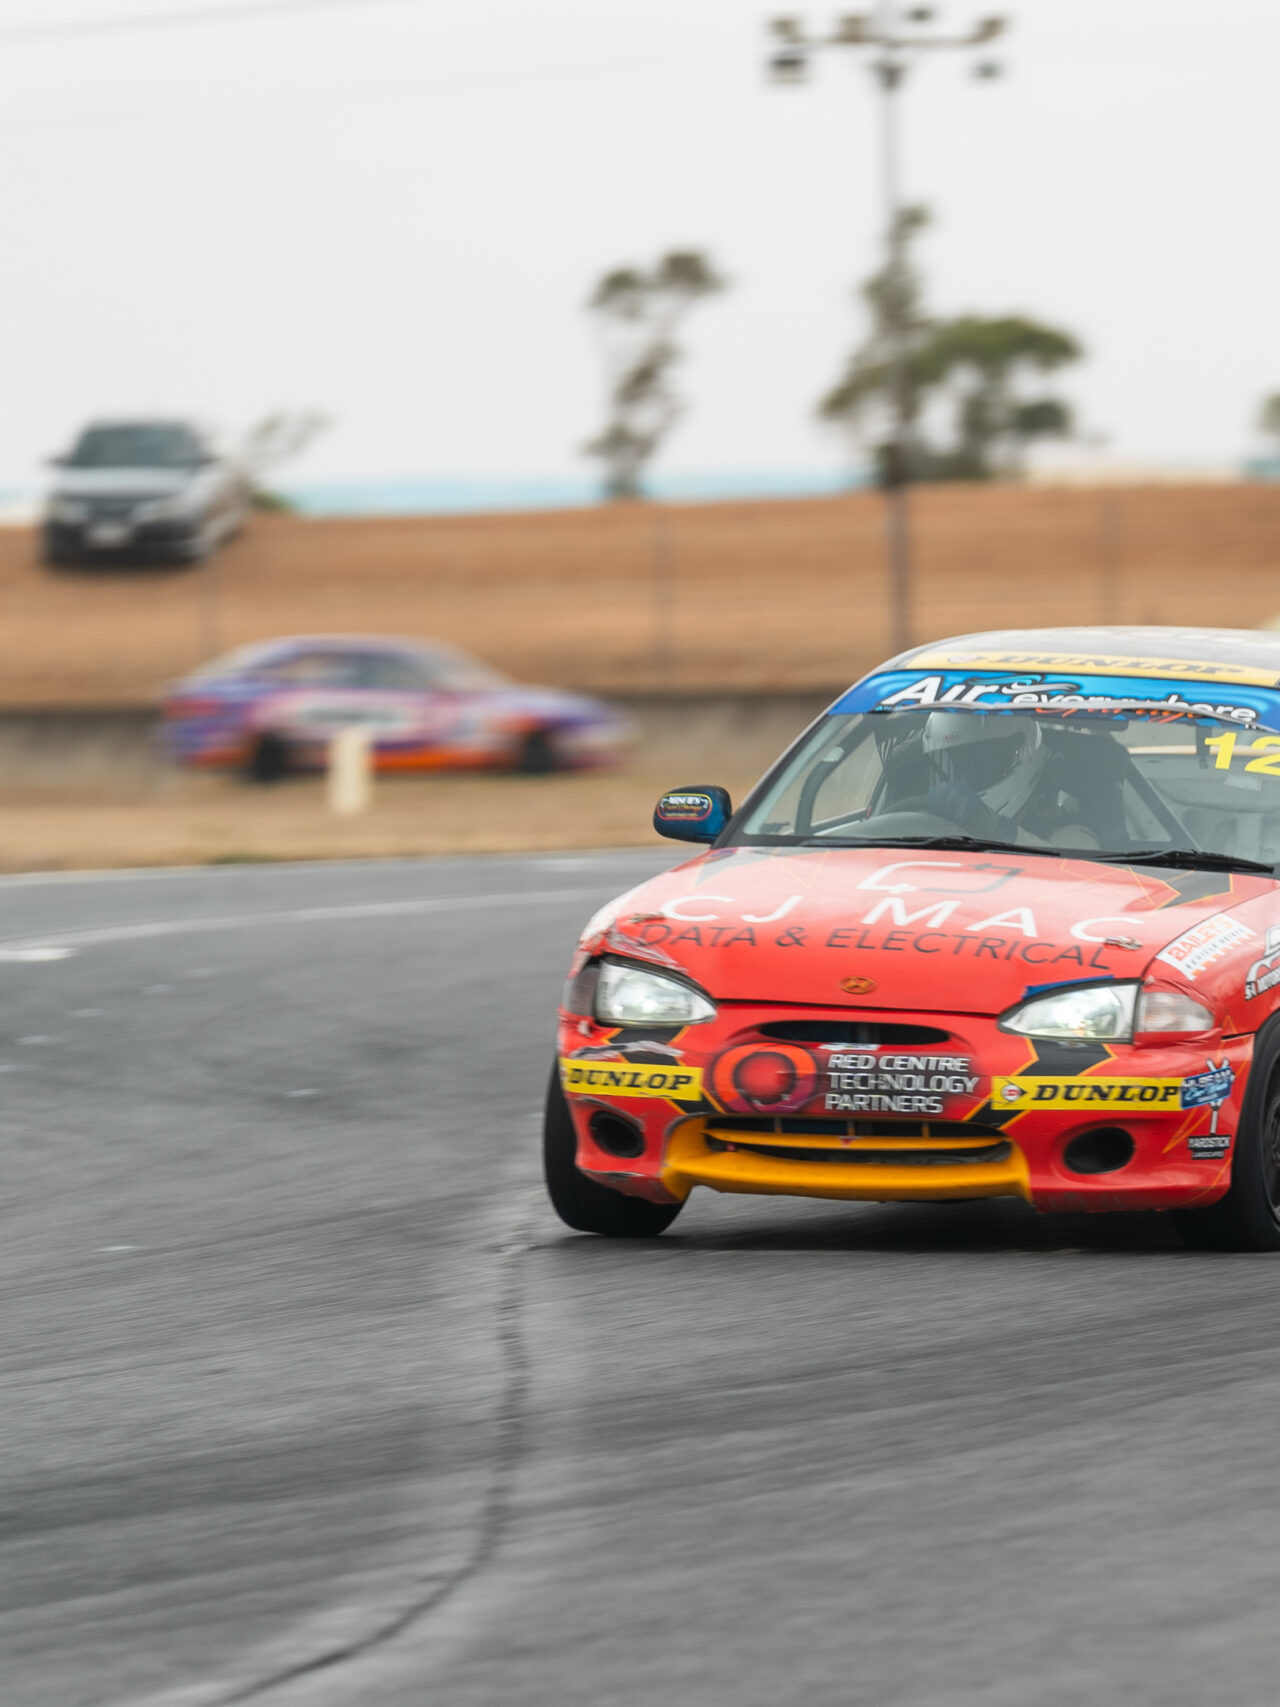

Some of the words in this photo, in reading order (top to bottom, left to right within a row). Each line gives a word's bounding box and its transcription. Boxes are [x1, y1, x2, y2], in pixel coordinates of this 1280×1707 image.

[996, 655, 1244, 674] DUNLOP
[880, 676, 999, 706] Air
[861, 897, 1145, 942] MAC
[638, 924, 756, 947] DATA
[775, 926, 808, 948] &
[824, 927, 1110, 970] ELECTRICAL
[828, 1054, 874, 1070] RED
[878, 1055, 970, 1072] CENTRE
[568, 1068, 692, 1091] DUNLOP
[828, 1072, 980, 1093] TECHNOLOGY
[825, 1094, 943, 1113] PARTNERS
[1031, 1084, 1181, 1102] DUNLOP
